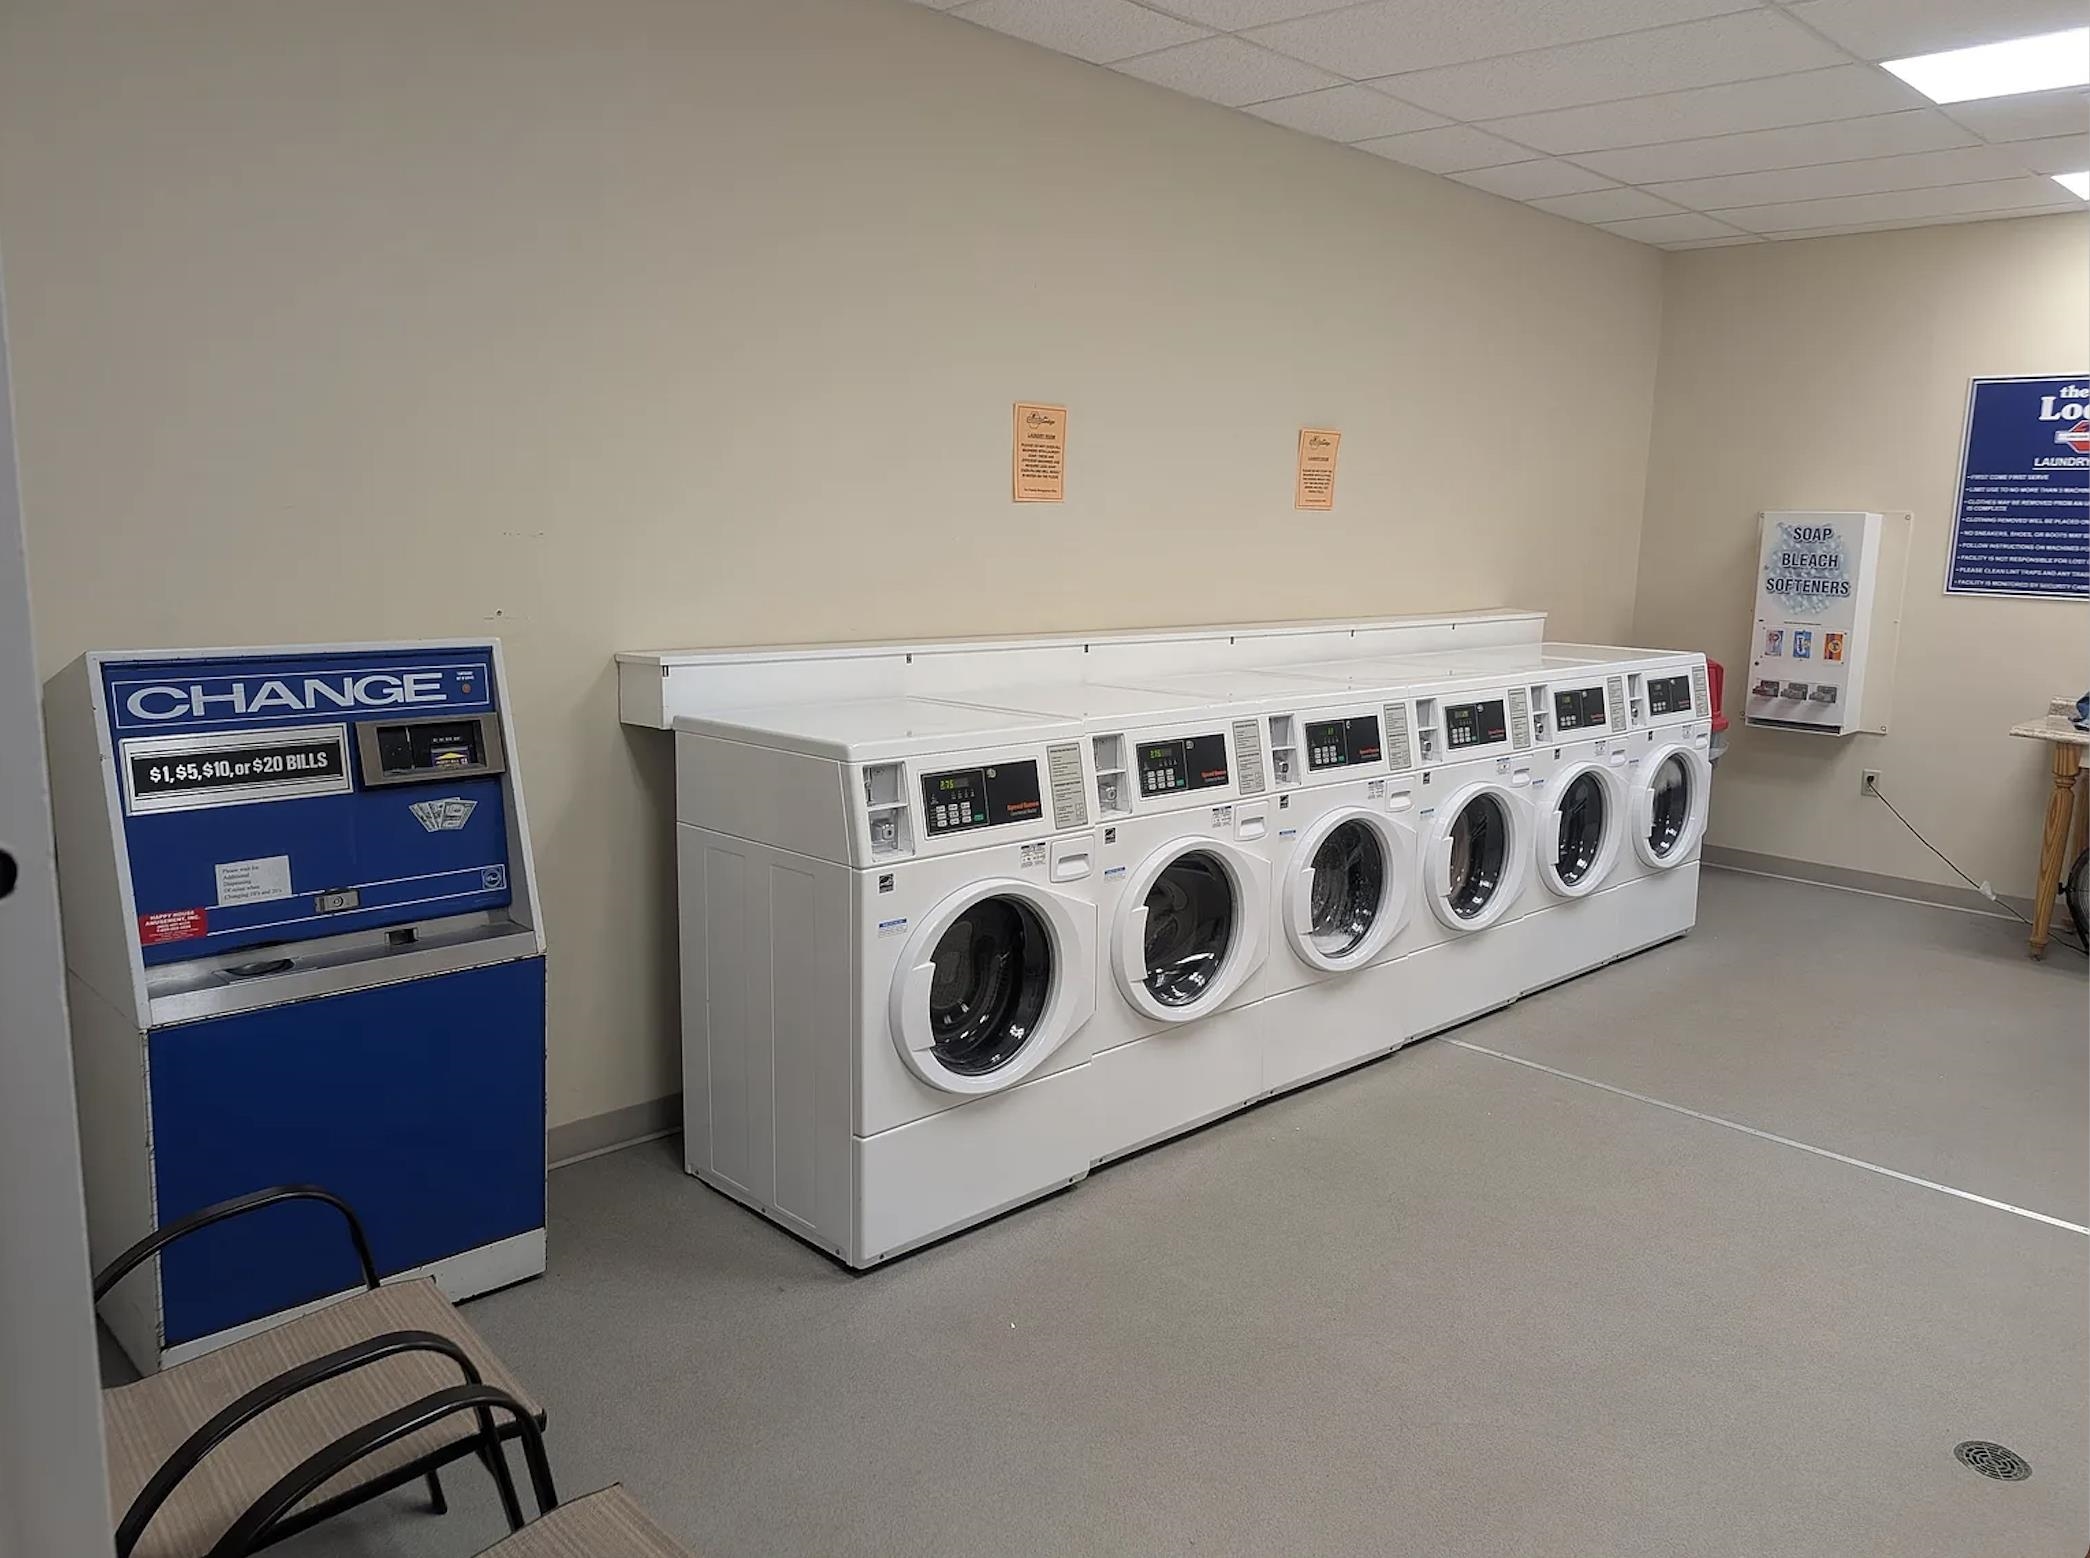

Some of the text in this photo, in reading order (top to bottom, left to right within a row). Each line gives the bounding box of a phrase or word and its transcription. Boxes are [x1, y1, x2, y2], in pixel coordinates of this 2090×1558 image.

[2060, 385, 2089, 398] the
[2038, 396, 2090, 420] Lo
[1793, 527, 1833, 542] SOAP
[1782, 552, 1839, 568] BLEACH
[1766, 578, 1850, 596] SOFTENERS
[127, 673, 447, 720] CHANGE
[252, 755, 283, 774] $20
[286, 752, 328, 770] BILLS
